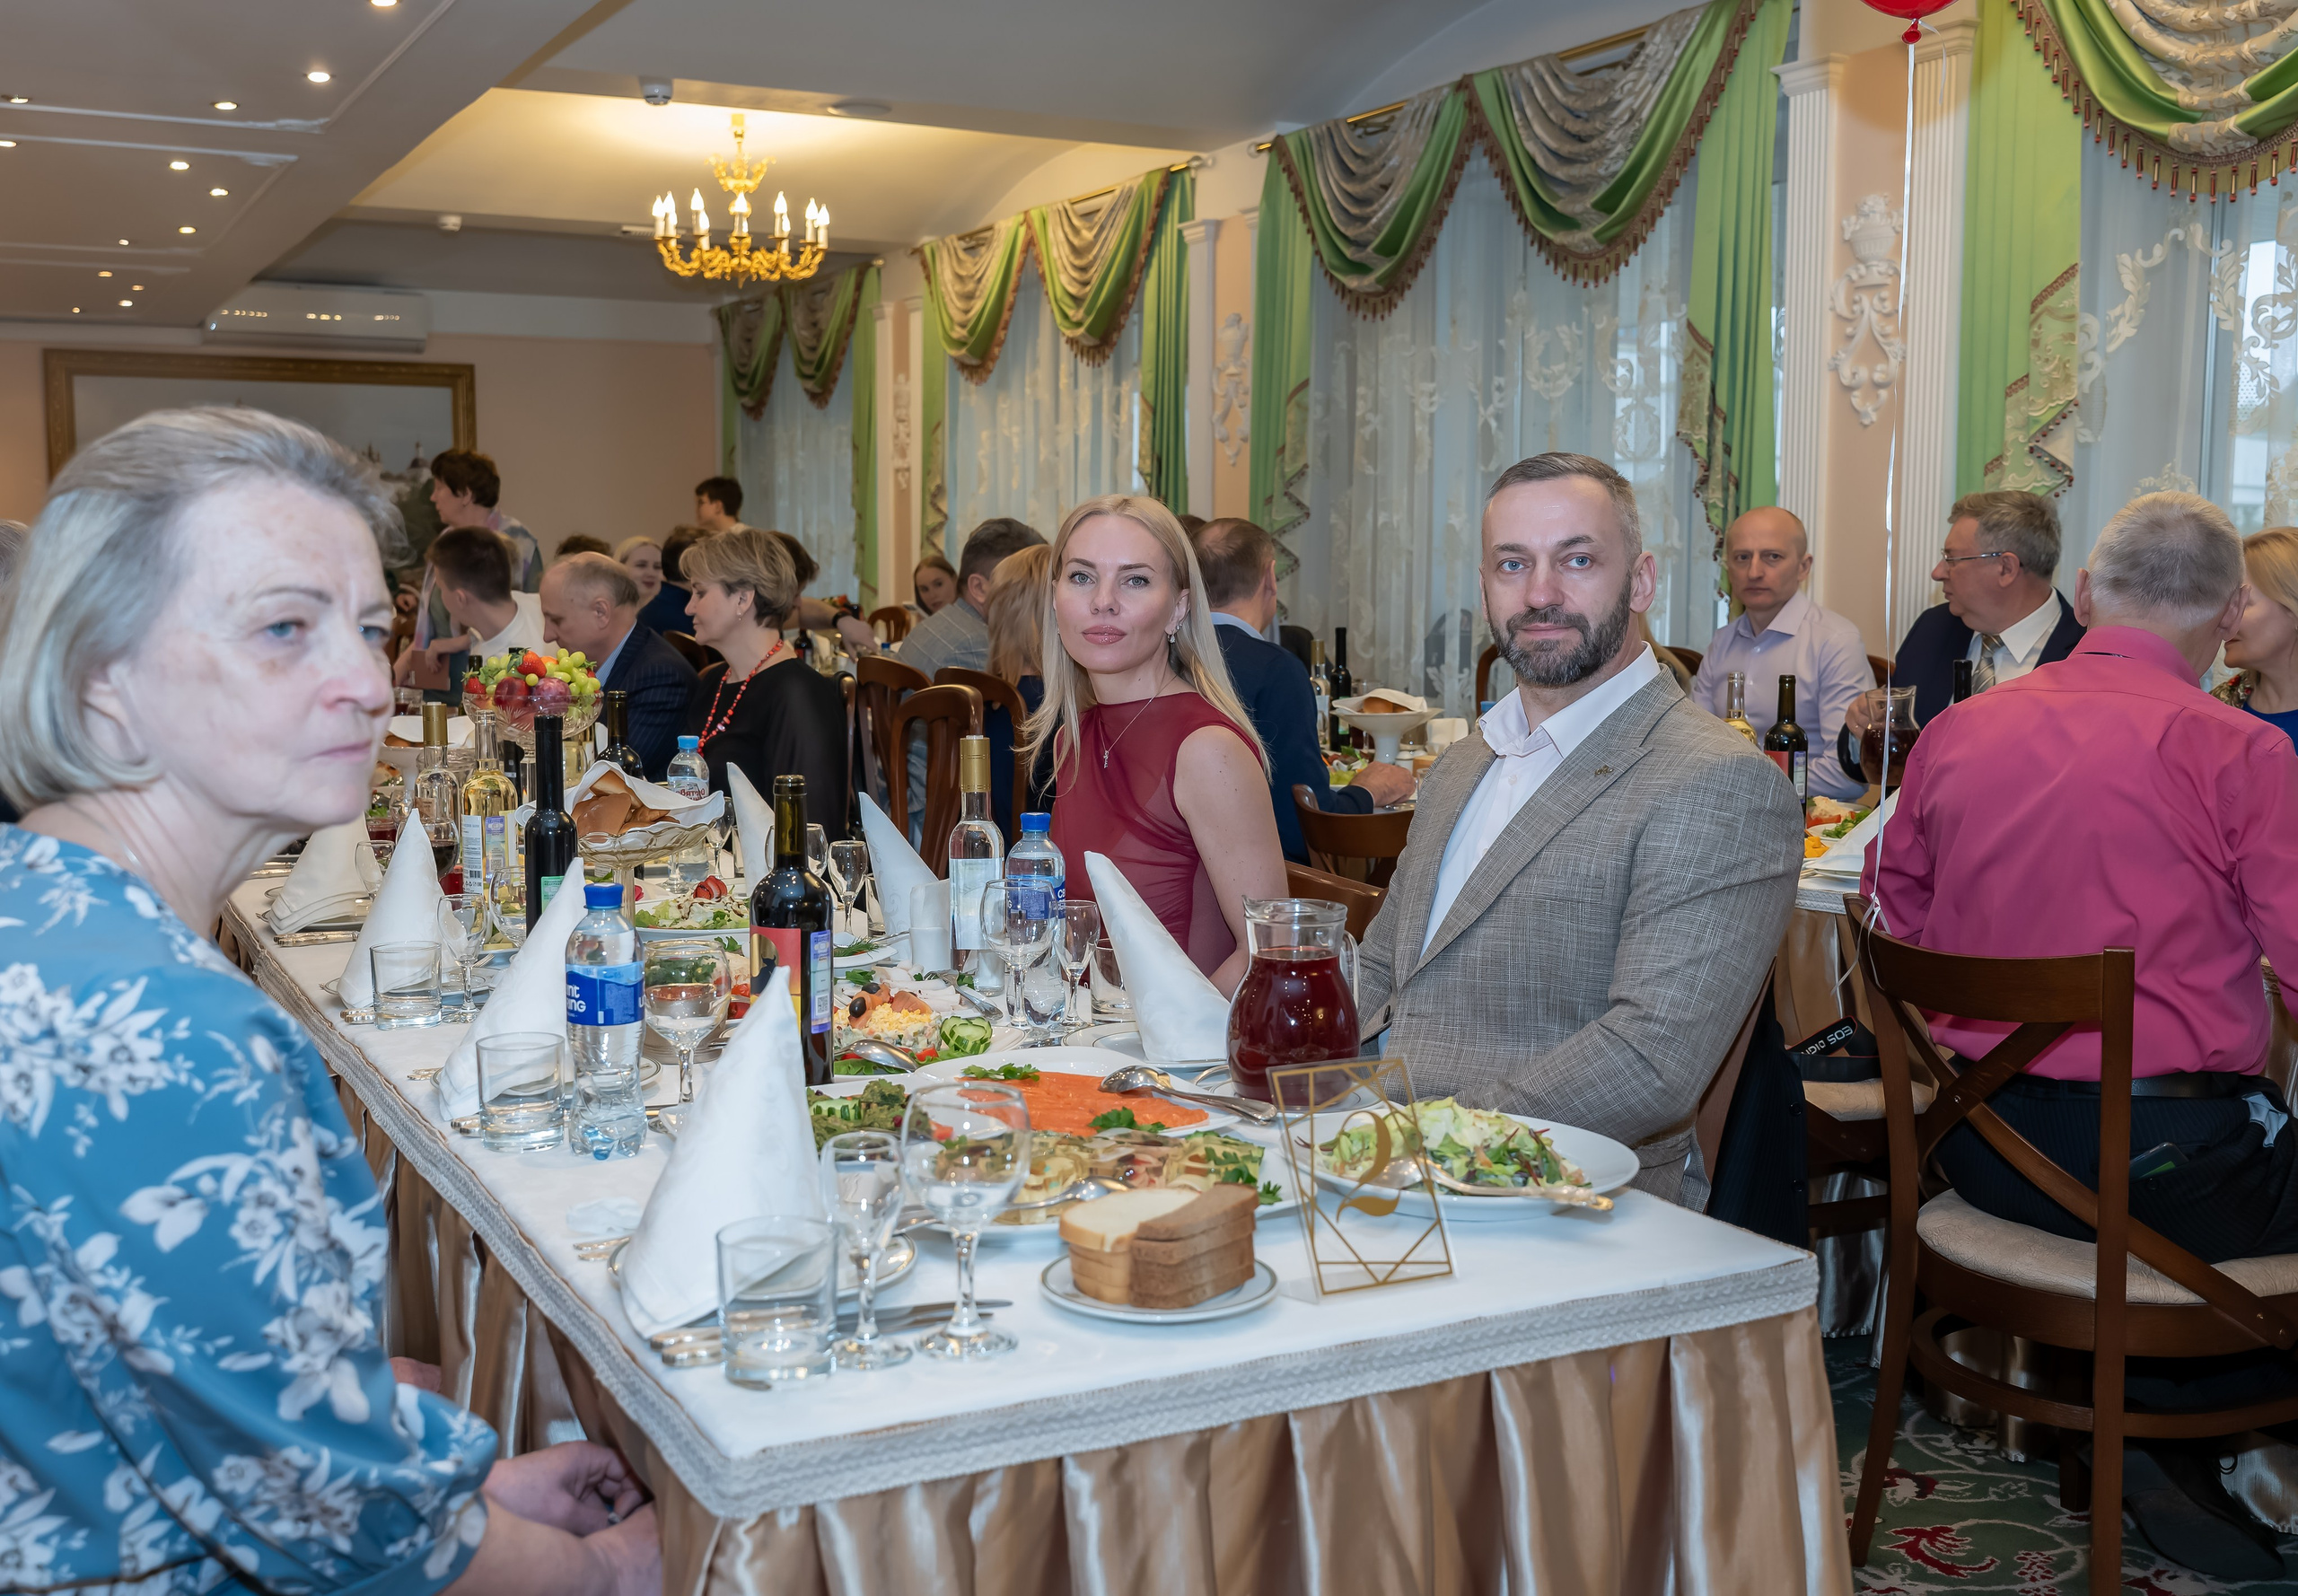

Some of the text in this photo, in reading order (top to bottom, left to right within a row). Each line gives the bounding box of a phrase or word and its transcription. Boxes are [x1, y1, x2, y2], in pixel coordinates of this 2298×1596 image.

[1801, 1025, 1854, 1055] EOS DIGI
[1337, 1110, 1401, 1223] 2
